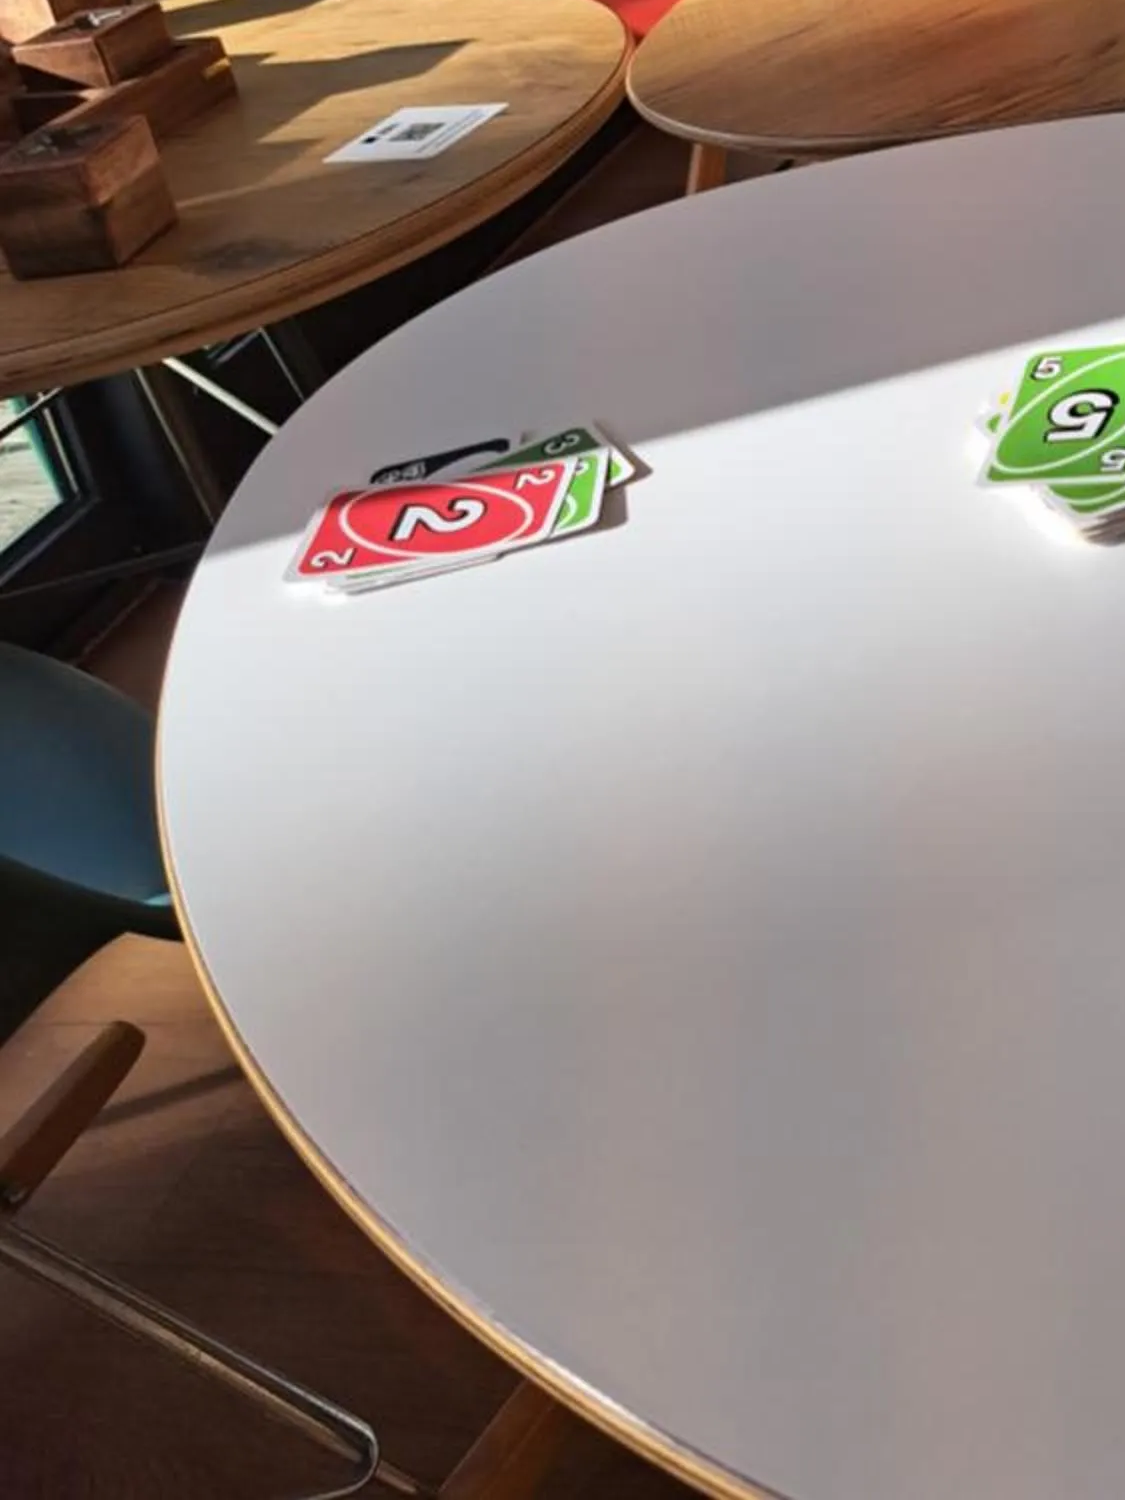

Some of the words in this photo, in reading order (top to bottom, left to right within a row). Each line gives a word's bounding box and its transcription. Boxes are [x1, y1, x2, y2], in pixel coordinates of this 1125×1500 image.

[1030, 357, 1063, 381] 5
[1043, 387, 1120, 444] 5
[513, 468, 556, 491] 2
[389, 497, 487, 542] 2
[310, 546, 357, 569] 2
